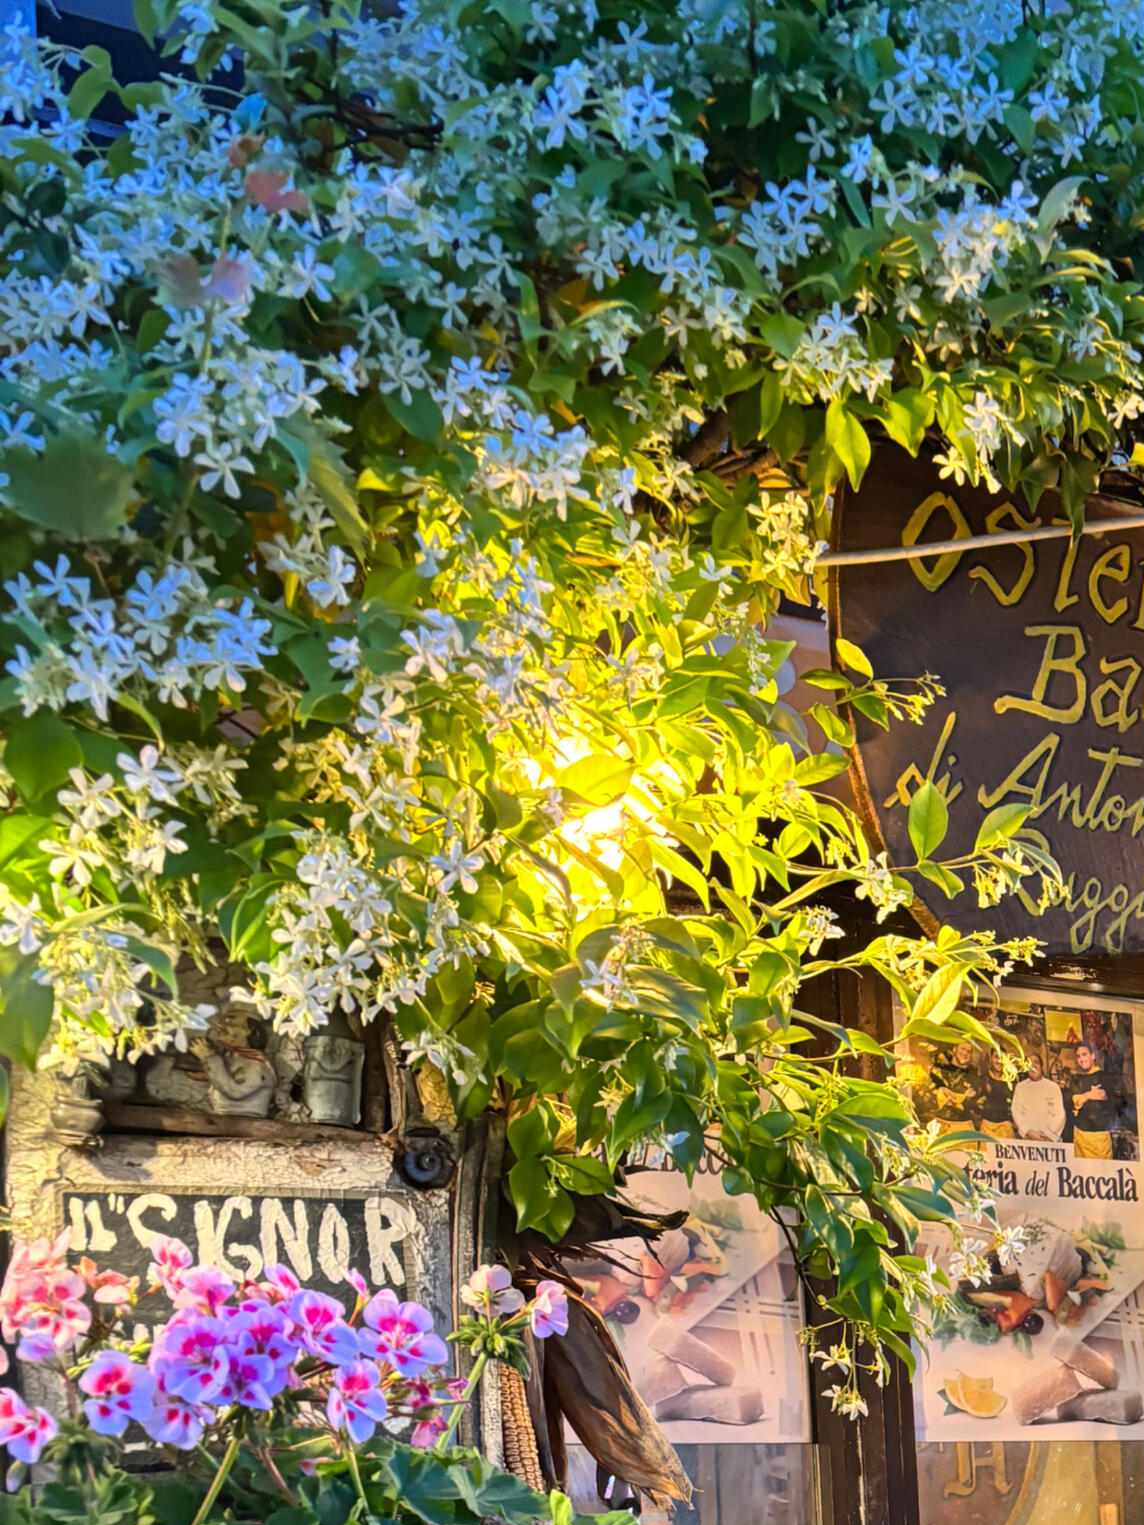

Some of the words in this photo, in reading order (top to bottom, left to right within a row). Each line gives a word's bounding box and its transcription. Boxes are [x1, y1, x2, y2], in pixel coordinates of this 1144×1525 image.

[883, 712, 962, 808] di
[994, 1144, 1067, 1163] BENVENUTI
[1025, 1170, 1050, 1197] del
[1056, 1166, 1140, 1202] Baccalà
